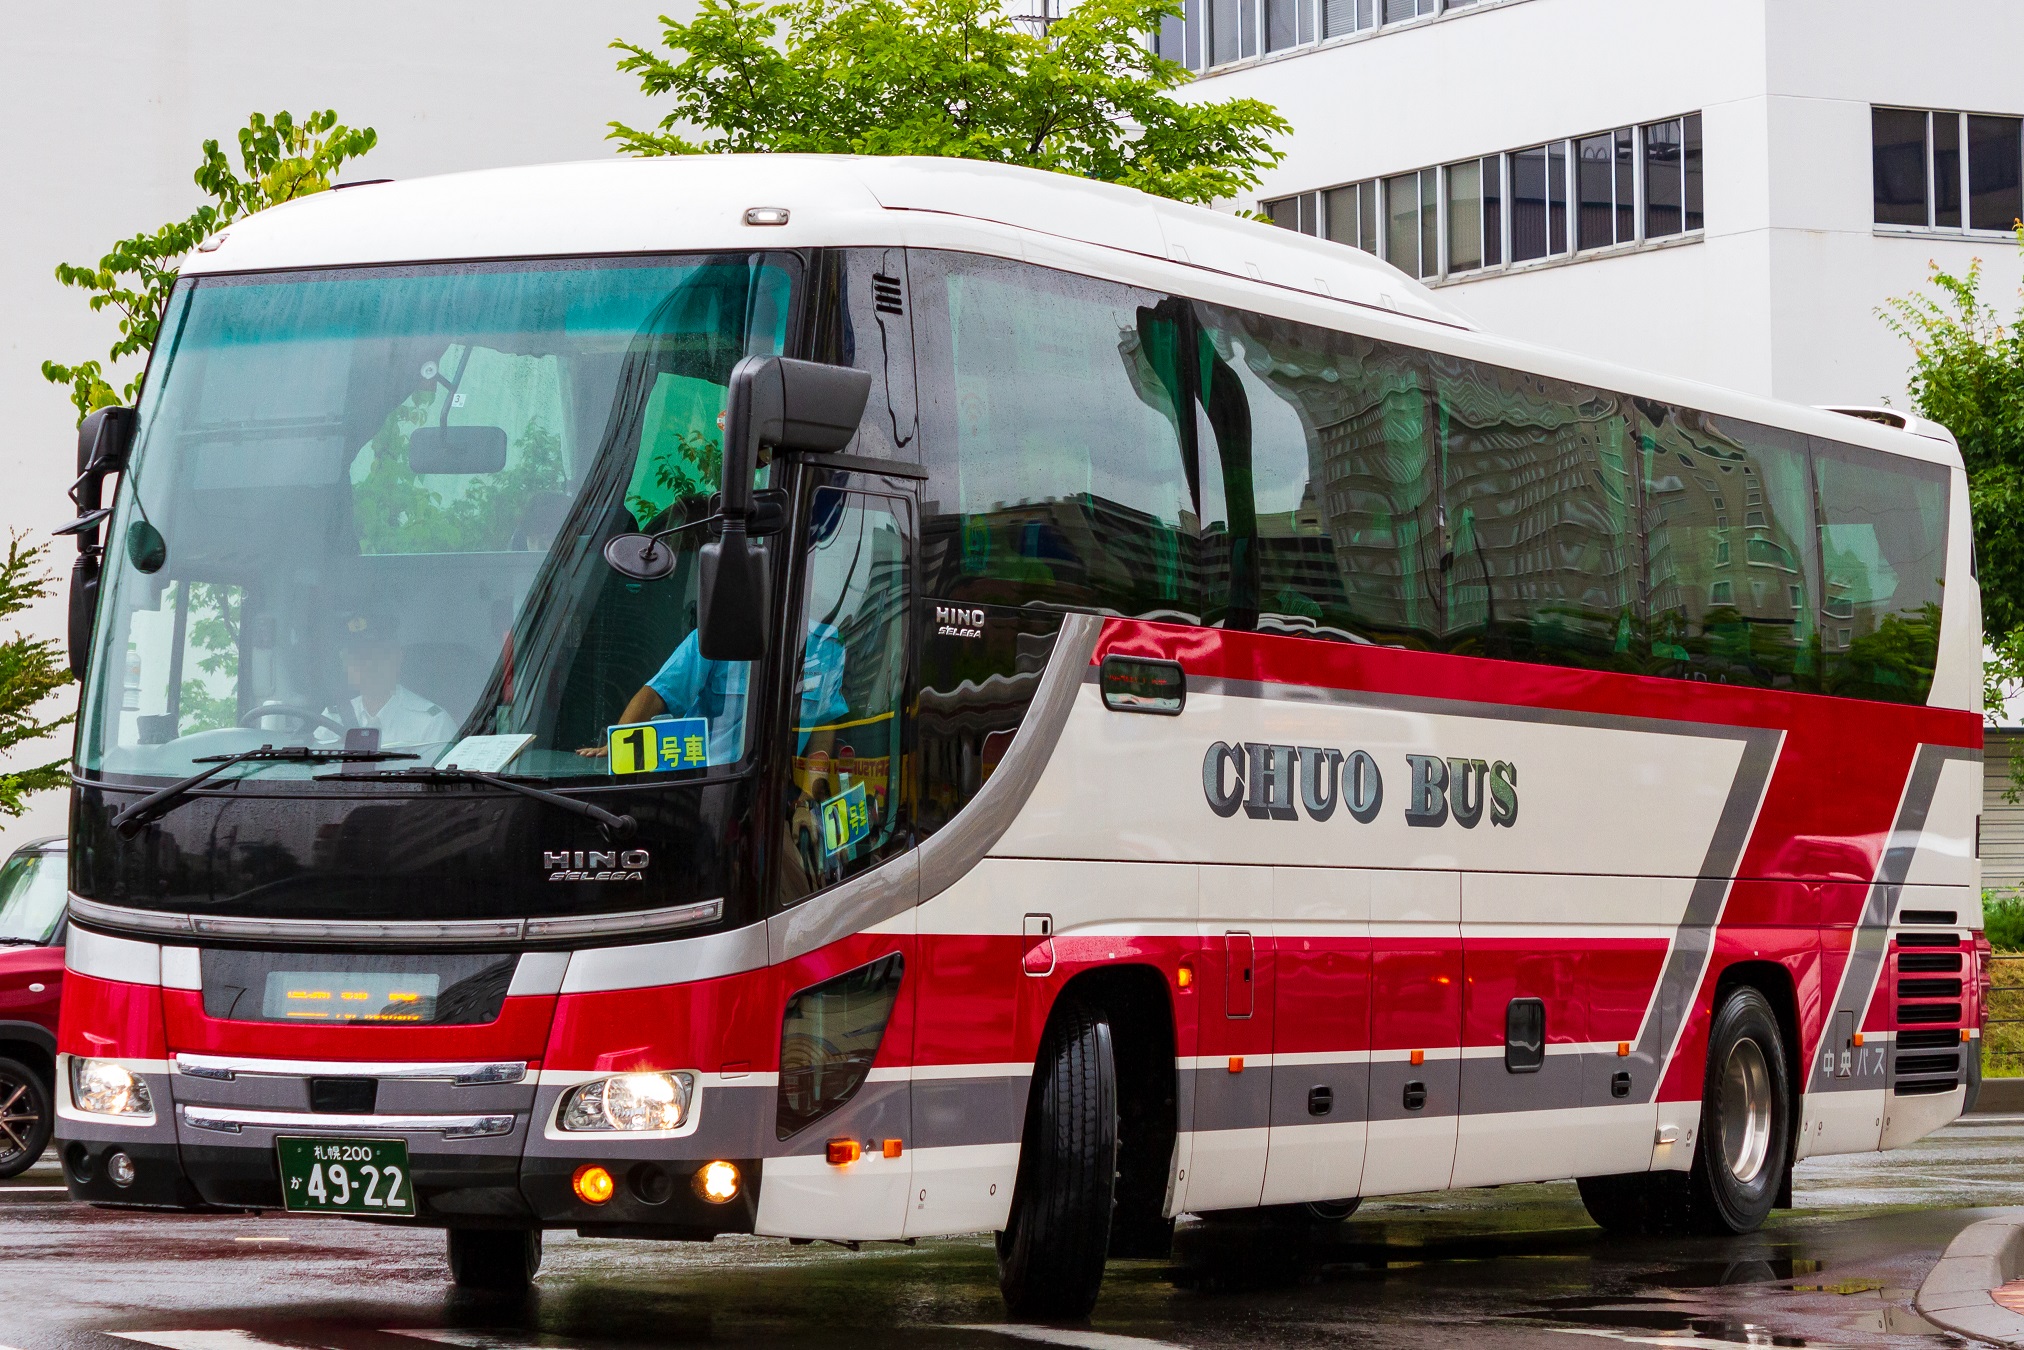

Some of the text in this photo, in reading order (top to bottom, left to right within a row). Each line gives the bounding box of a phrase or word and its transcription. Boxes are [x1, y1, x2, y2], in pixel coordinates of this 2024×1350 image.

[936, 606, 985, 628] HINO
[1202, 740, 1519, 830] CHUO BUS
[543, 849, 650, 869] HINO
[1822, 1047, 1885, 1079] 中央バス
[307, 1162, 406, 1207] 49-22
